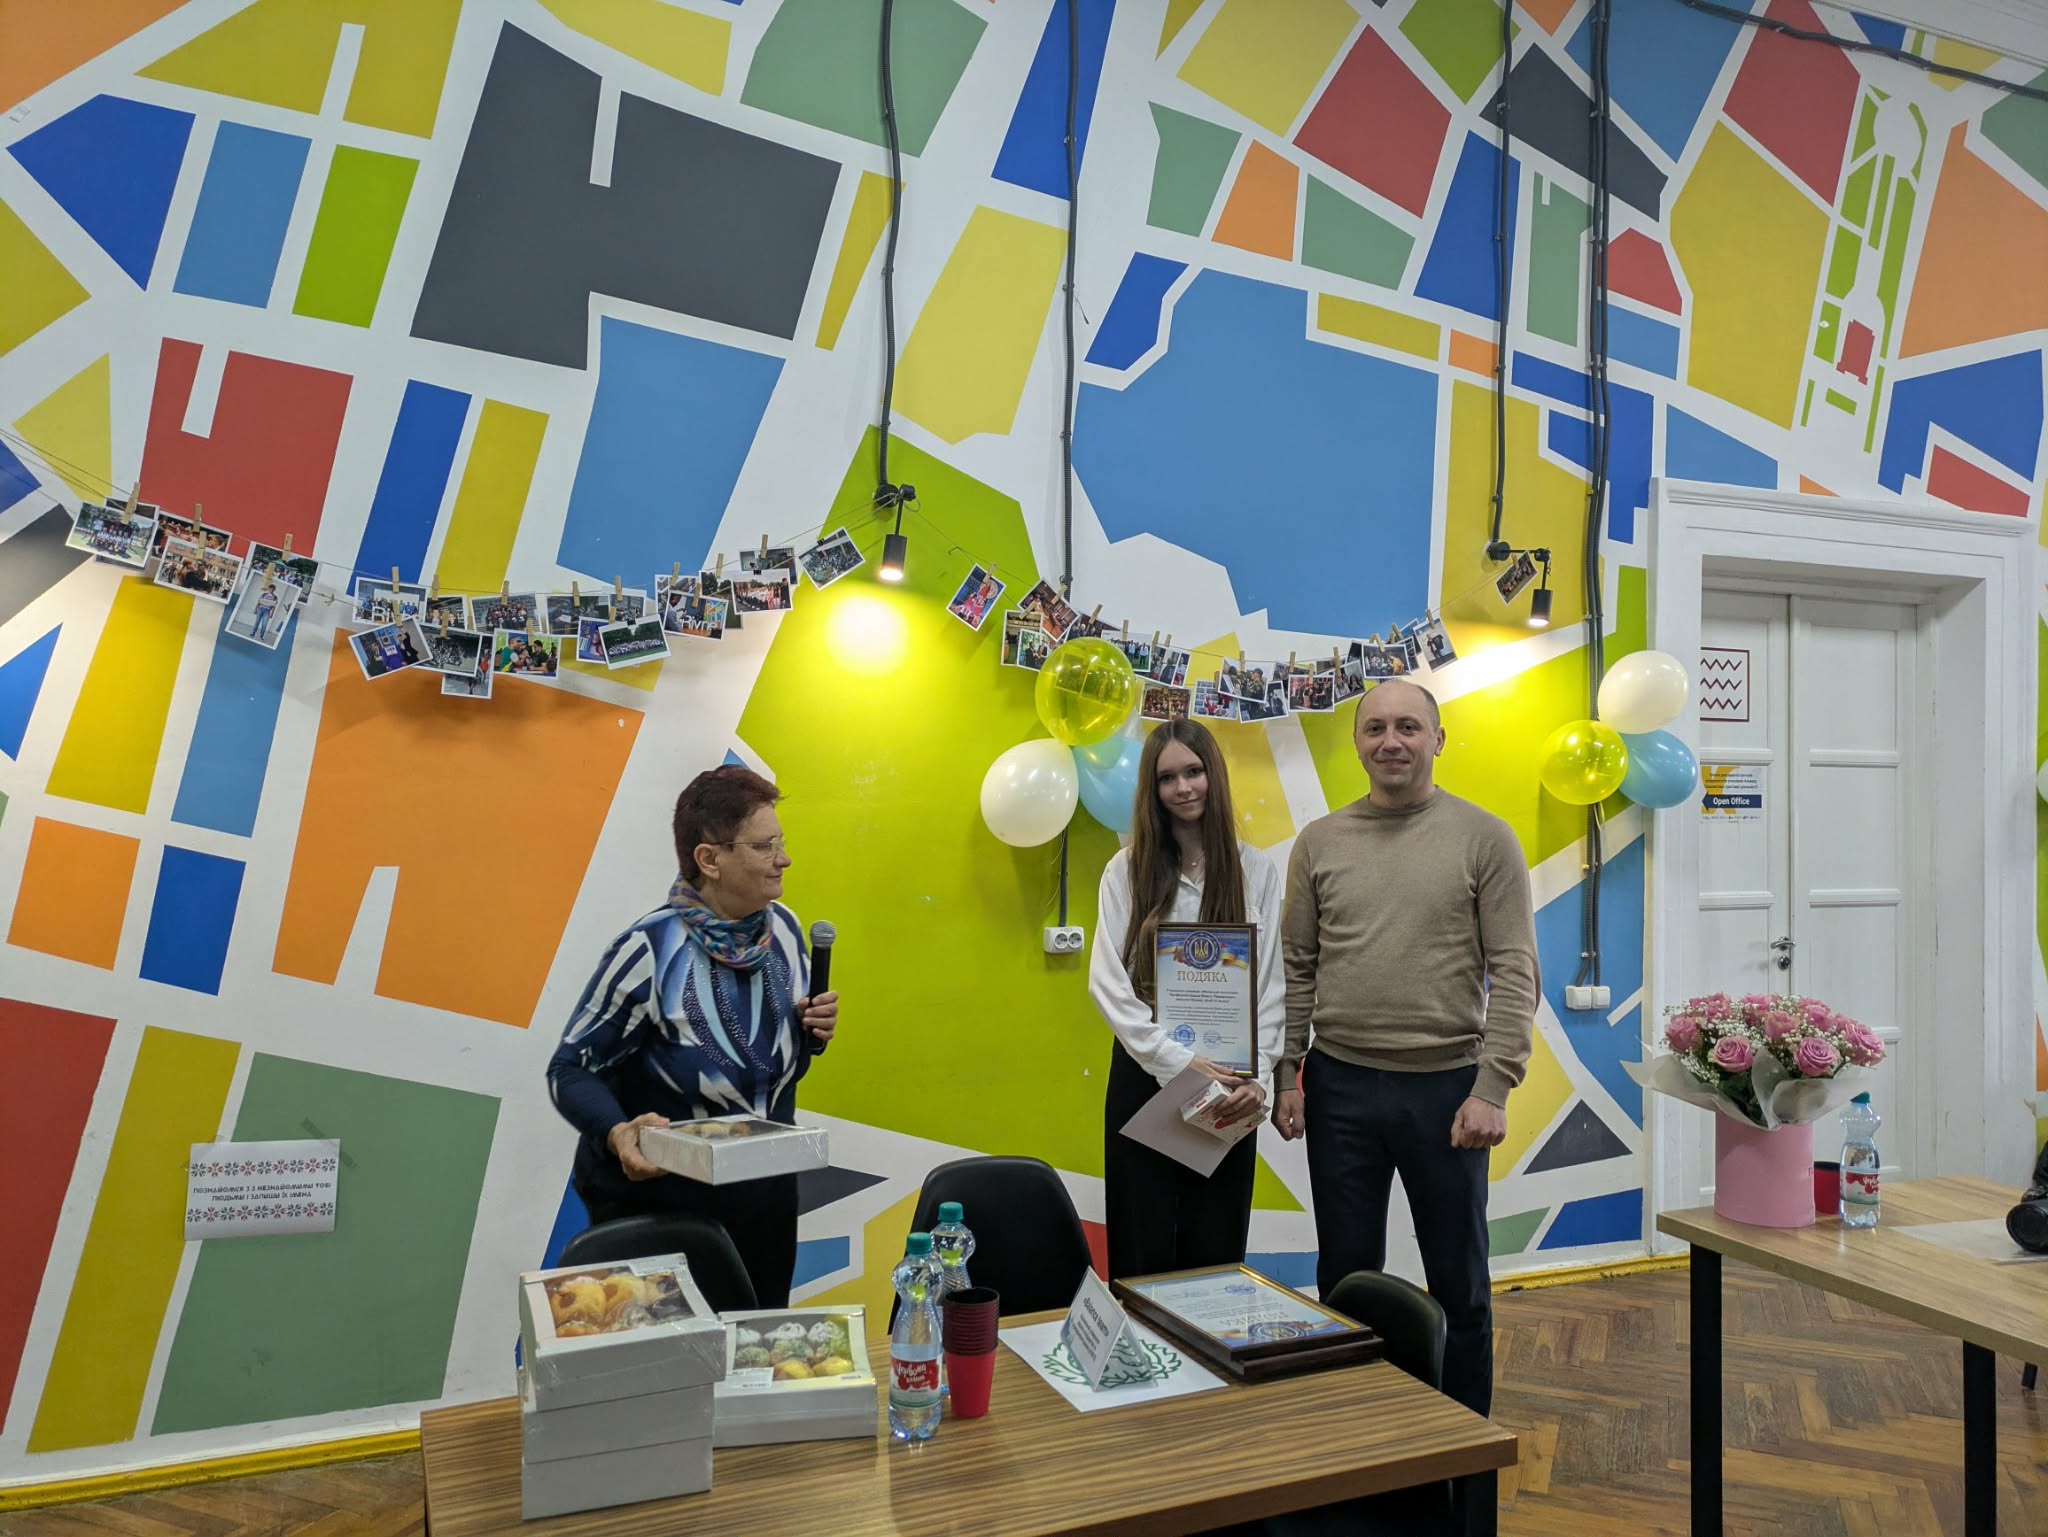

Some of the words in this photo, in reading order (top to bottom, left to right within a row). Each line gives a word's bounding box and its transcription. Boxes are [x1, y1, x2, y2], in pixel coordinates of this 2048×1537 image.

[681, 615, 717, 630] Rivne
[1713, 797, 1730, 806] Open
[1731, 796, 1750, 805] Office
[1177, 970, 1228, 983] ПОДЯКА
